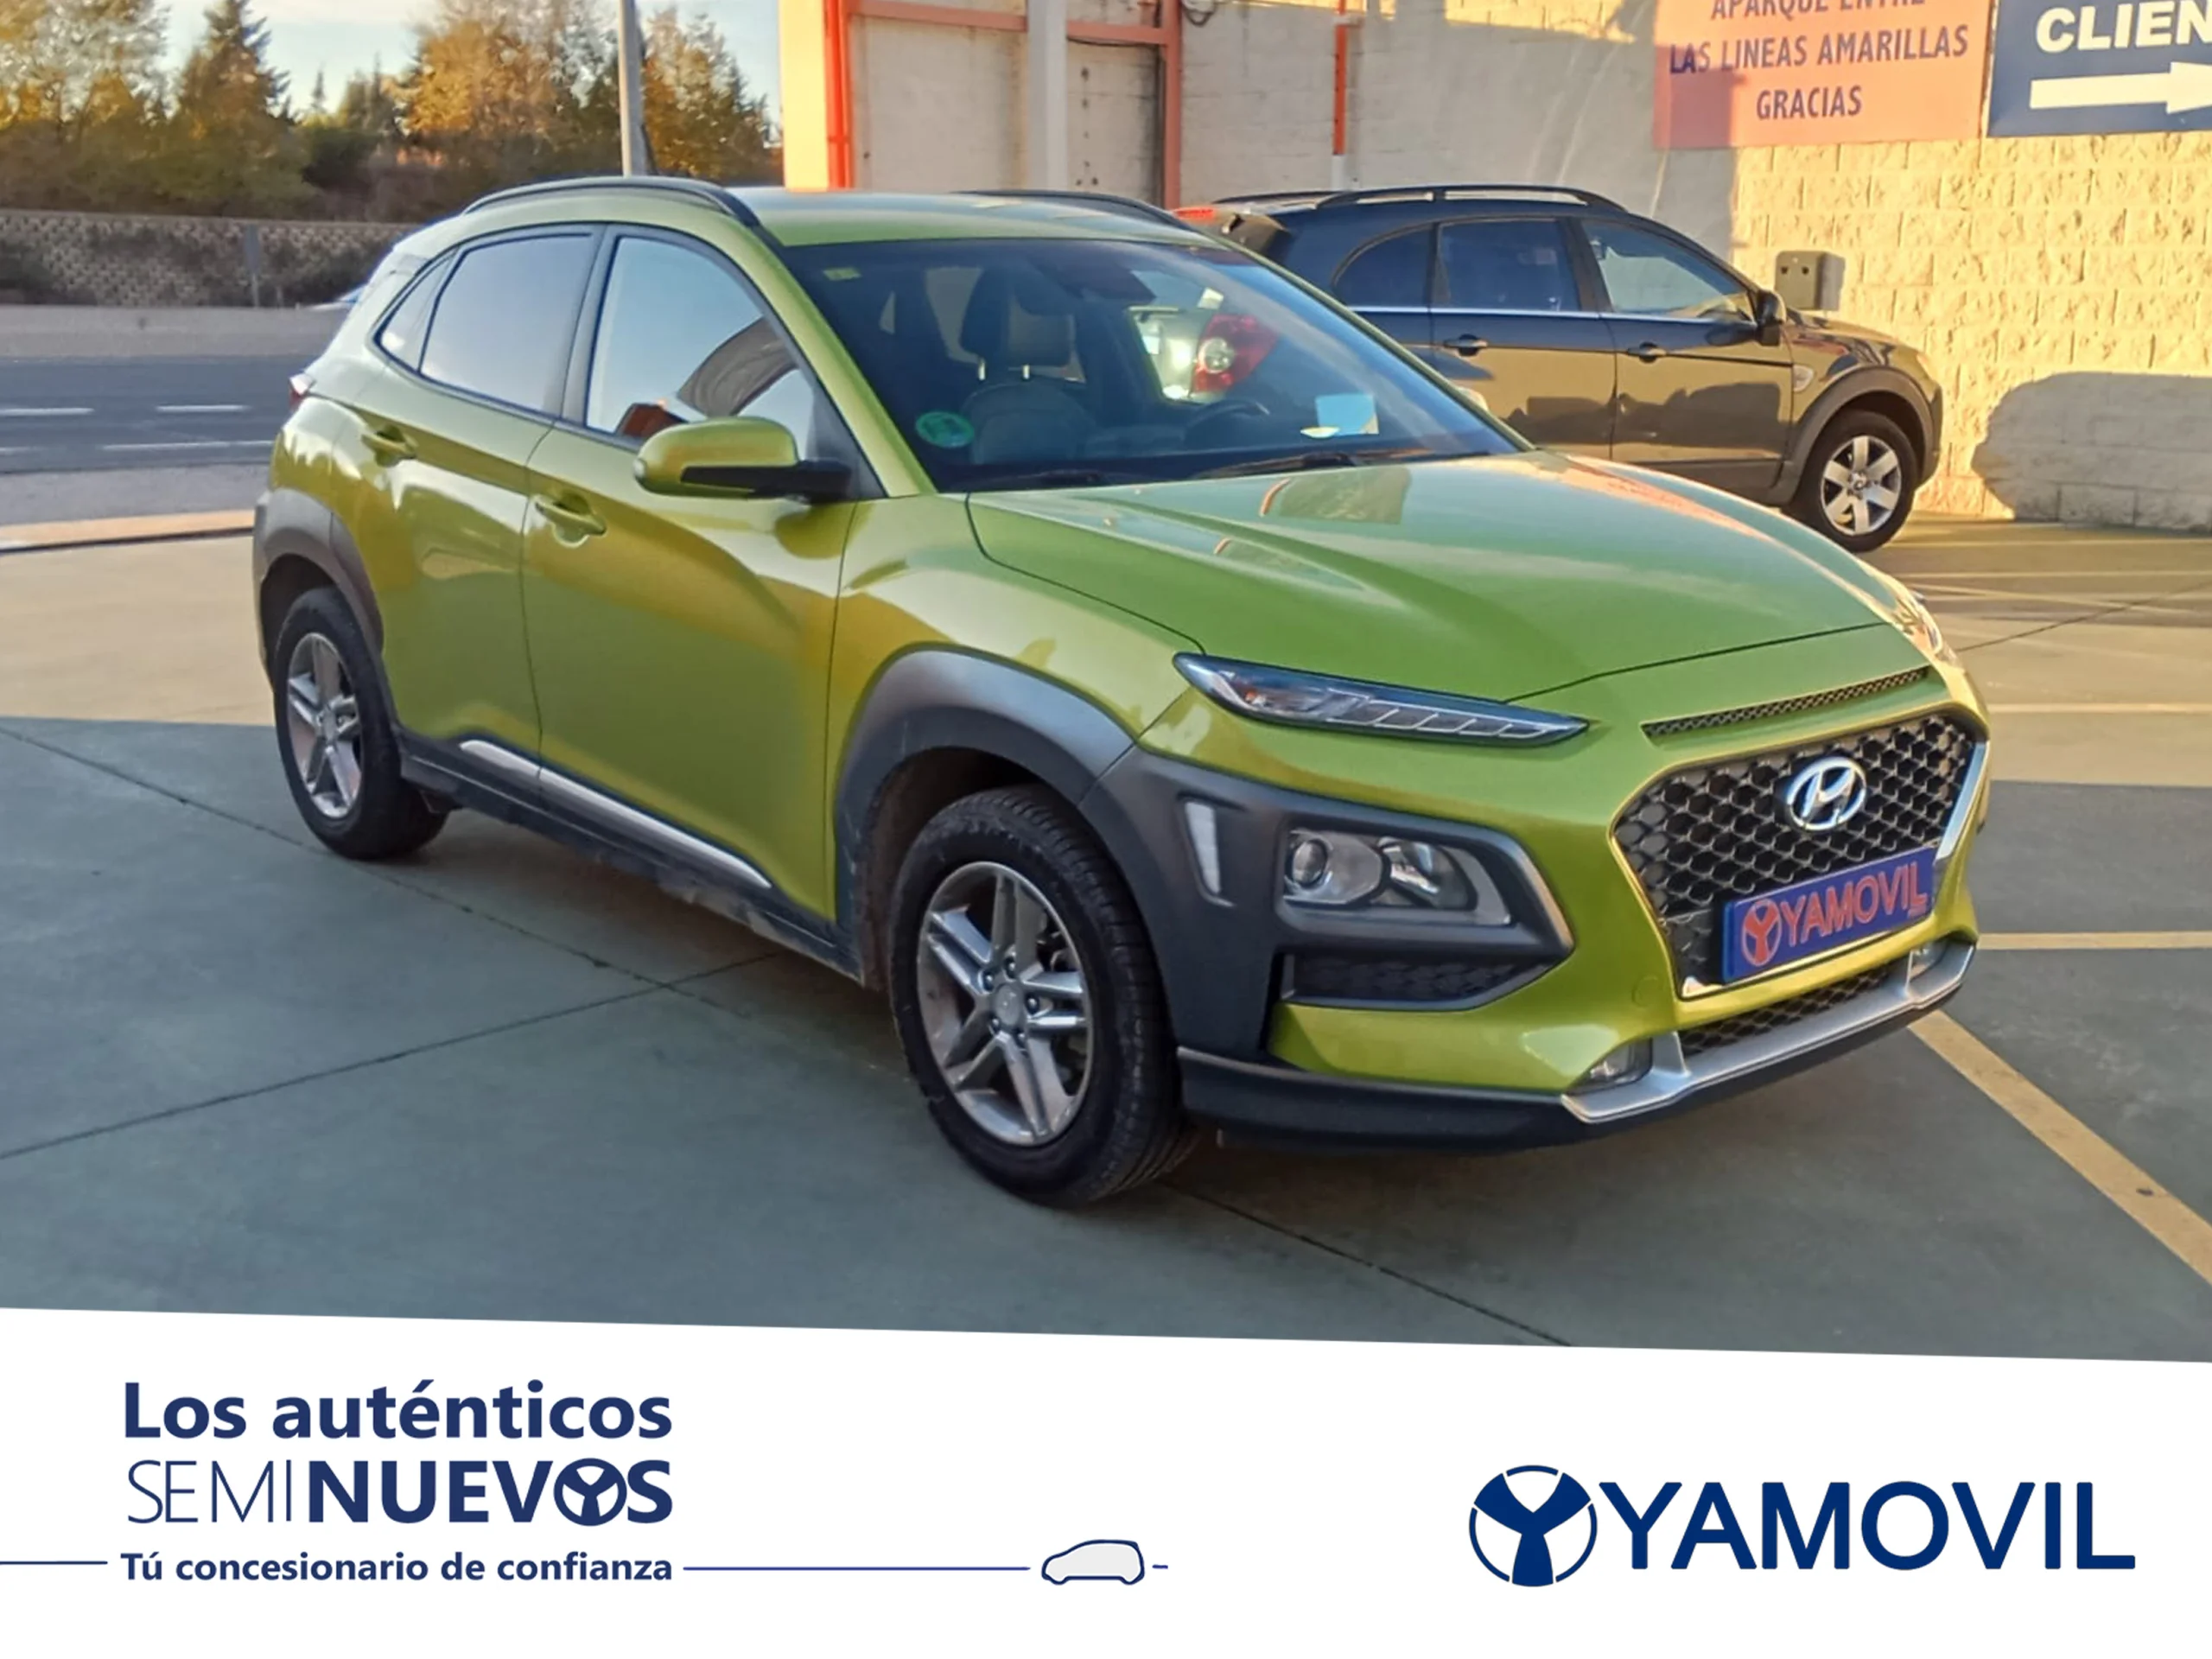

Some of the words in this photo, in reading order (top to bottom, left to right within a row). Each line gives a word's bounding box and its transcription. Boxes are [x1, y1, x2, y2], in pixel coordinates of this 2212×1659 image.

[1670, 41, 1711, 73] LAS
[1721, 35, 1808, 72] LINEAS
[1817, 25, 1968, 66] AMARILLAS
[2037, 0, 2212, 53] CLIEN
[1757, 86, 1862, 119] GRACIAS
[1781, 861, 1928, 946] YAMOVIL
